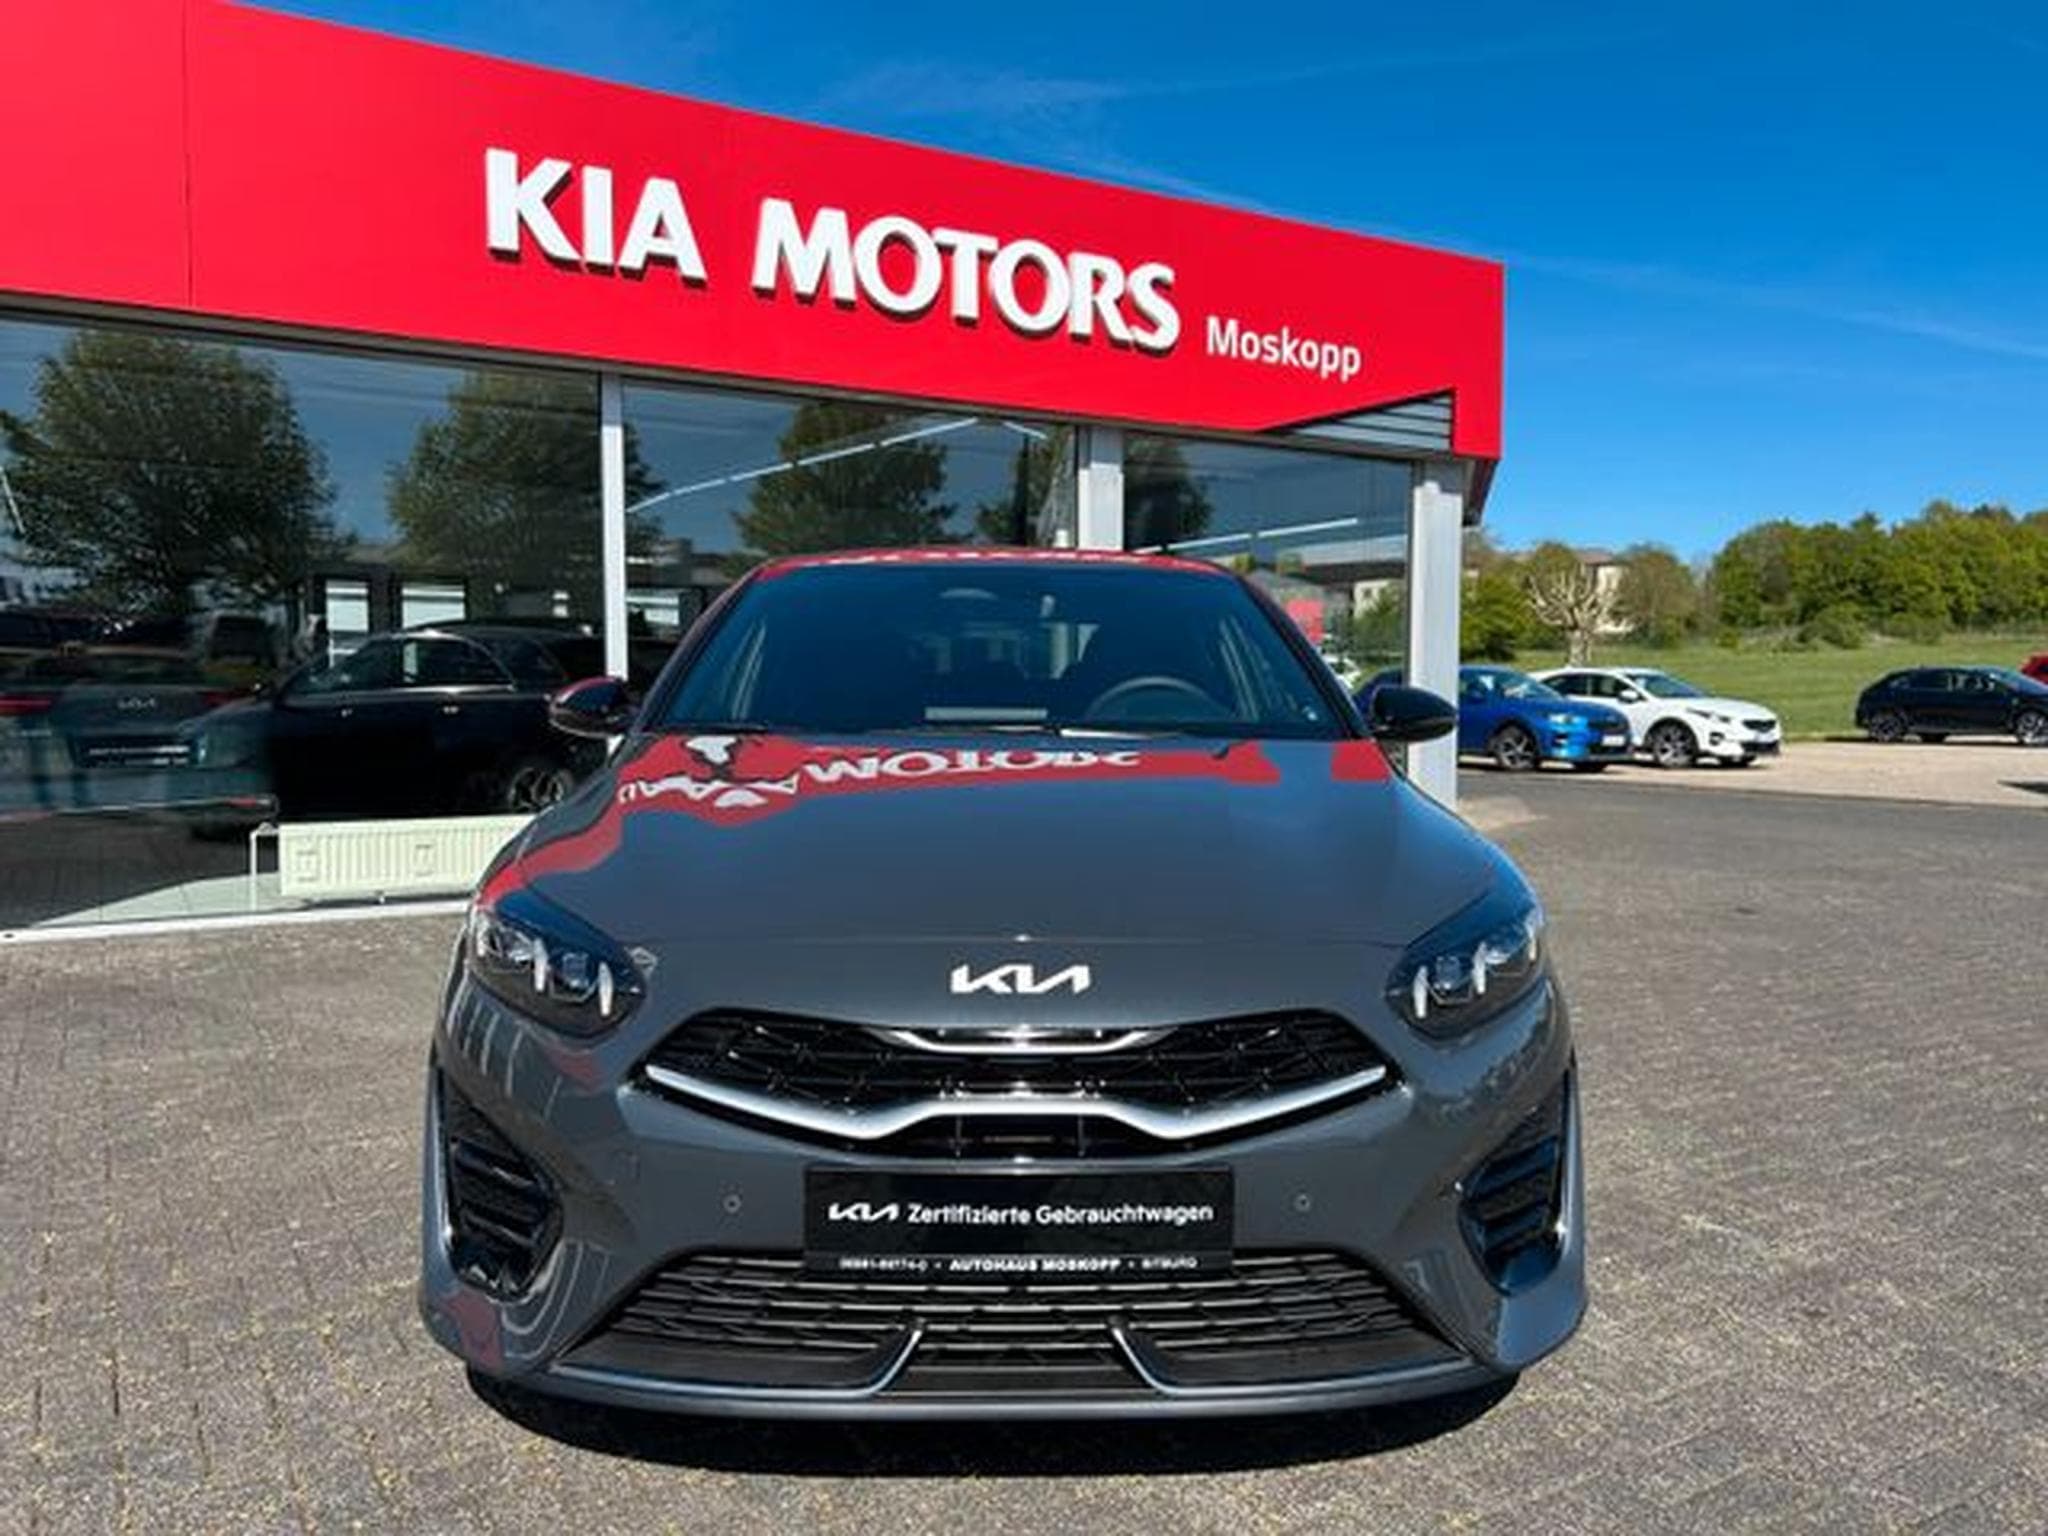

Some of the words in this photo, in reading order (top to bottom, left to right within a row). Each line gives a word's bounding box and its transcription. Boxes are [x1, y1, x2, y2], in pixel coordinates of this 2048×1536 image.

[485, 147, 708, 280] KIA
[751, 197, 1181, 352] MOTORS
[1206, 314, 1362, 383] Moskopp
[951, 964, 1090, 994] KIA
[907, 1203, 1031, 1225] Zertifizierte
[1036, 1203, 1214, 1226] Gebrauchtwagen
[949, 1258, 1037, 1272] AUTOHAUS
[1042, 1258, 1121, 1272] MOSKOPP
